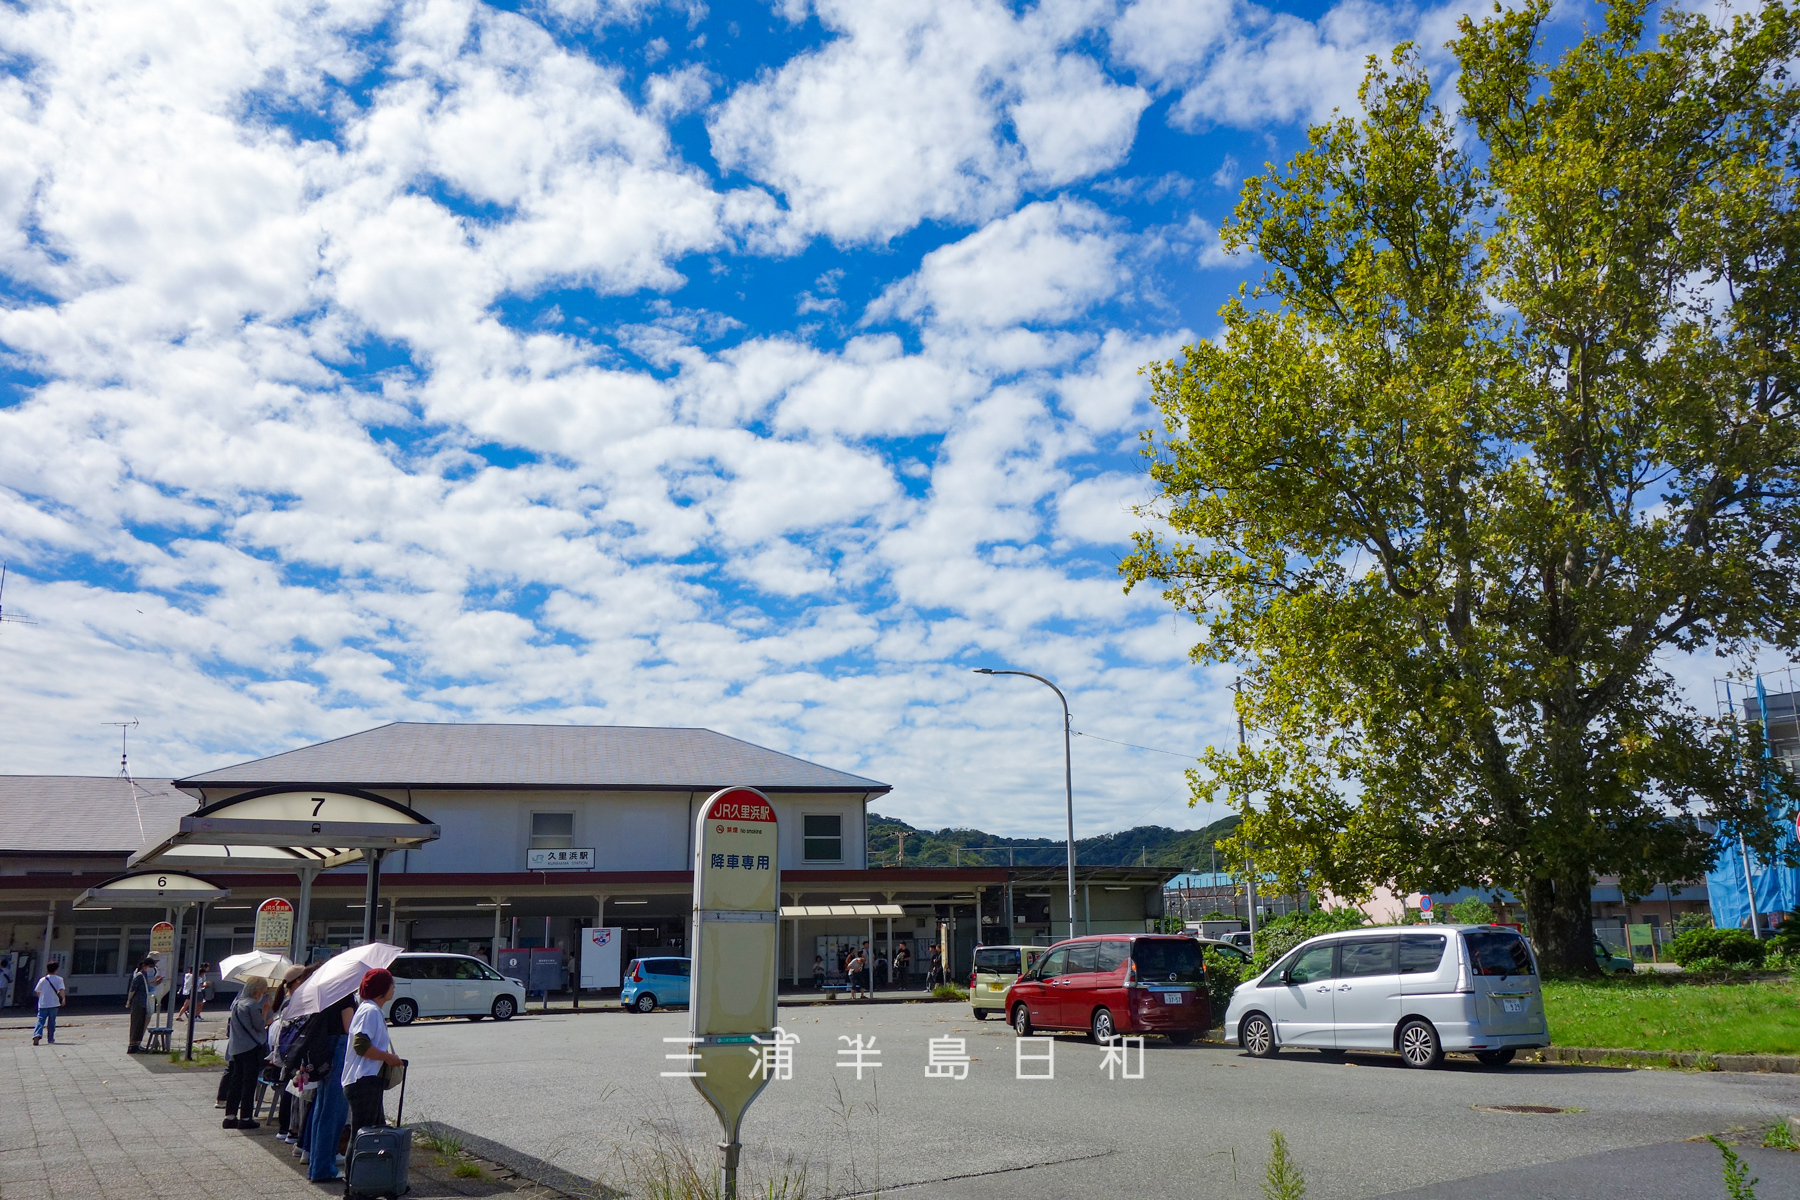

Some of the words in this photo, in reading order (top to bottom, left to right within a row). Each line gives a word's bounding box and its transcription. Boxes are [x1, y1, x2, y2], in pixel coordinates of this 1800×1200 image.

[311, 797, 326, 817] 7
[714, 803, 770, 820] JR久里浜駅
[532, 854, 544, 862] JR
[547, 851, 589, 861] 久里浜駅
[711, 853, 769, 870] 降車専用
[157, 876, 167, 887] 6
